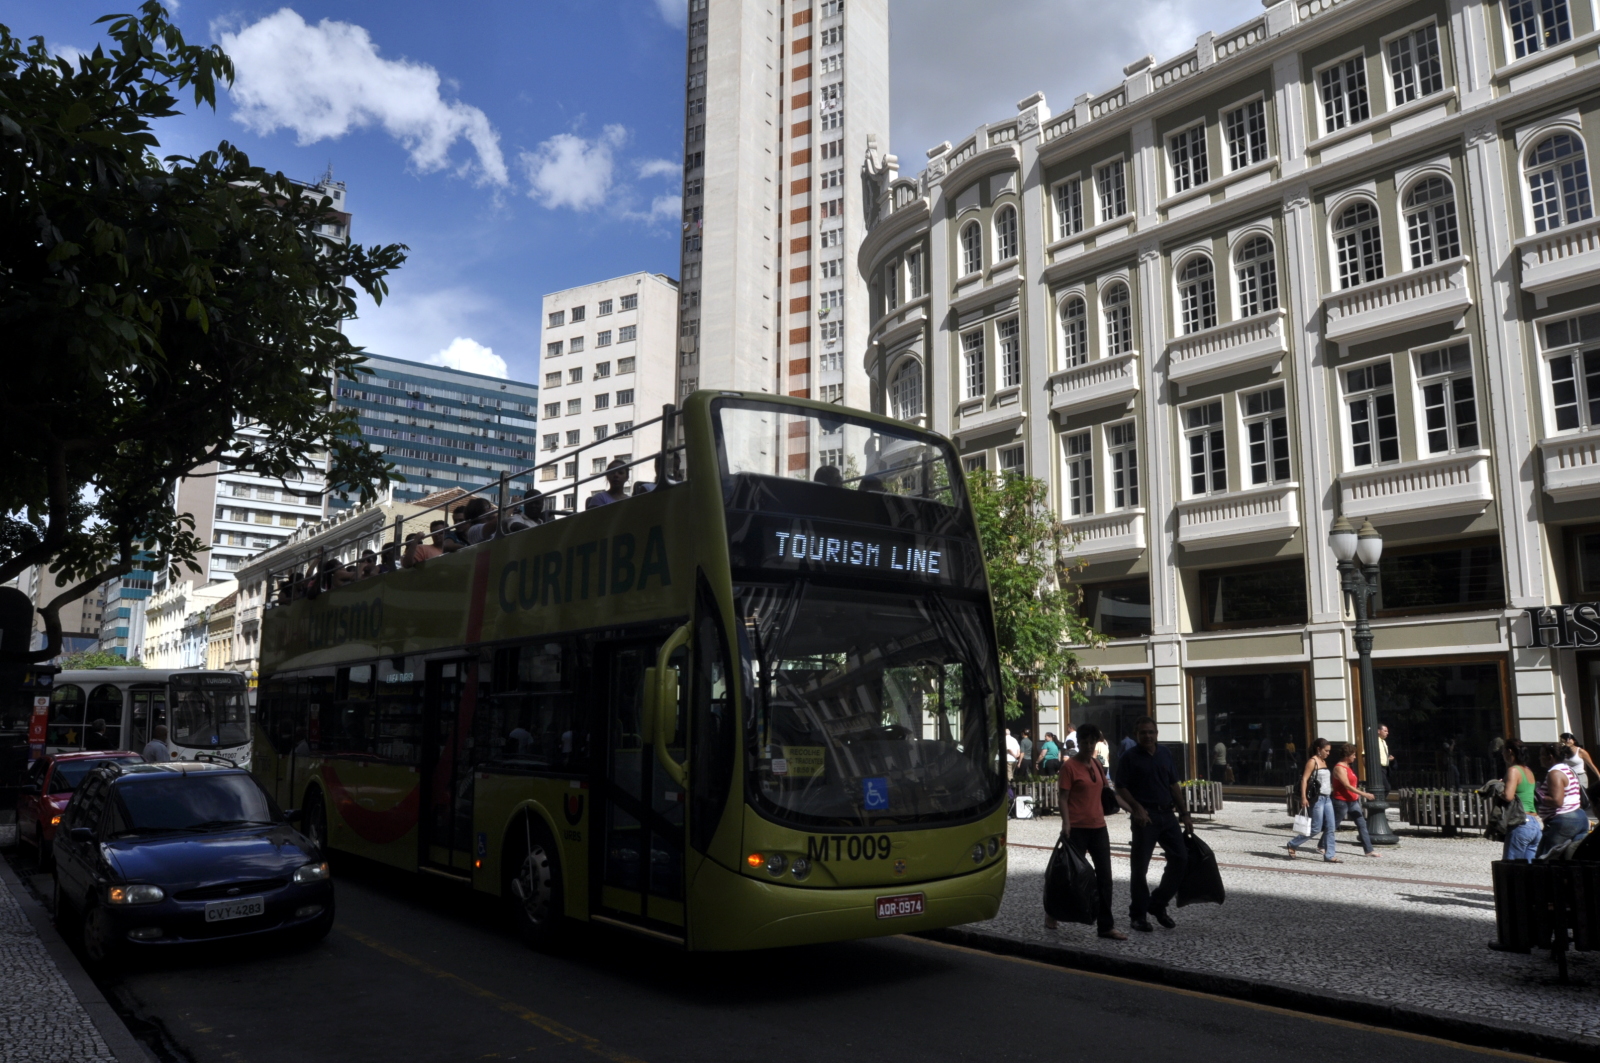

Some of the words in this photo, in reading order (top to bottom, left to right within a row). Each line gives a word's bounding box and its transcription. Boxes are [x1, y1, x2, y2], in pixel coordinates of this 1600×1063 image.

[776, 532, 880, 567] TOURISM
[891, 546, 941, 573] LINE
[499, 525, 672, 614] CURITIBA
[308, 597, 383, 649] turismo
[789, 748, 821, 756] RECOLHE
[564, 830, 582, 842] URBS
[806, 834, 892, 862] MT009
[208, 903, 261, 920] CVY-4283
